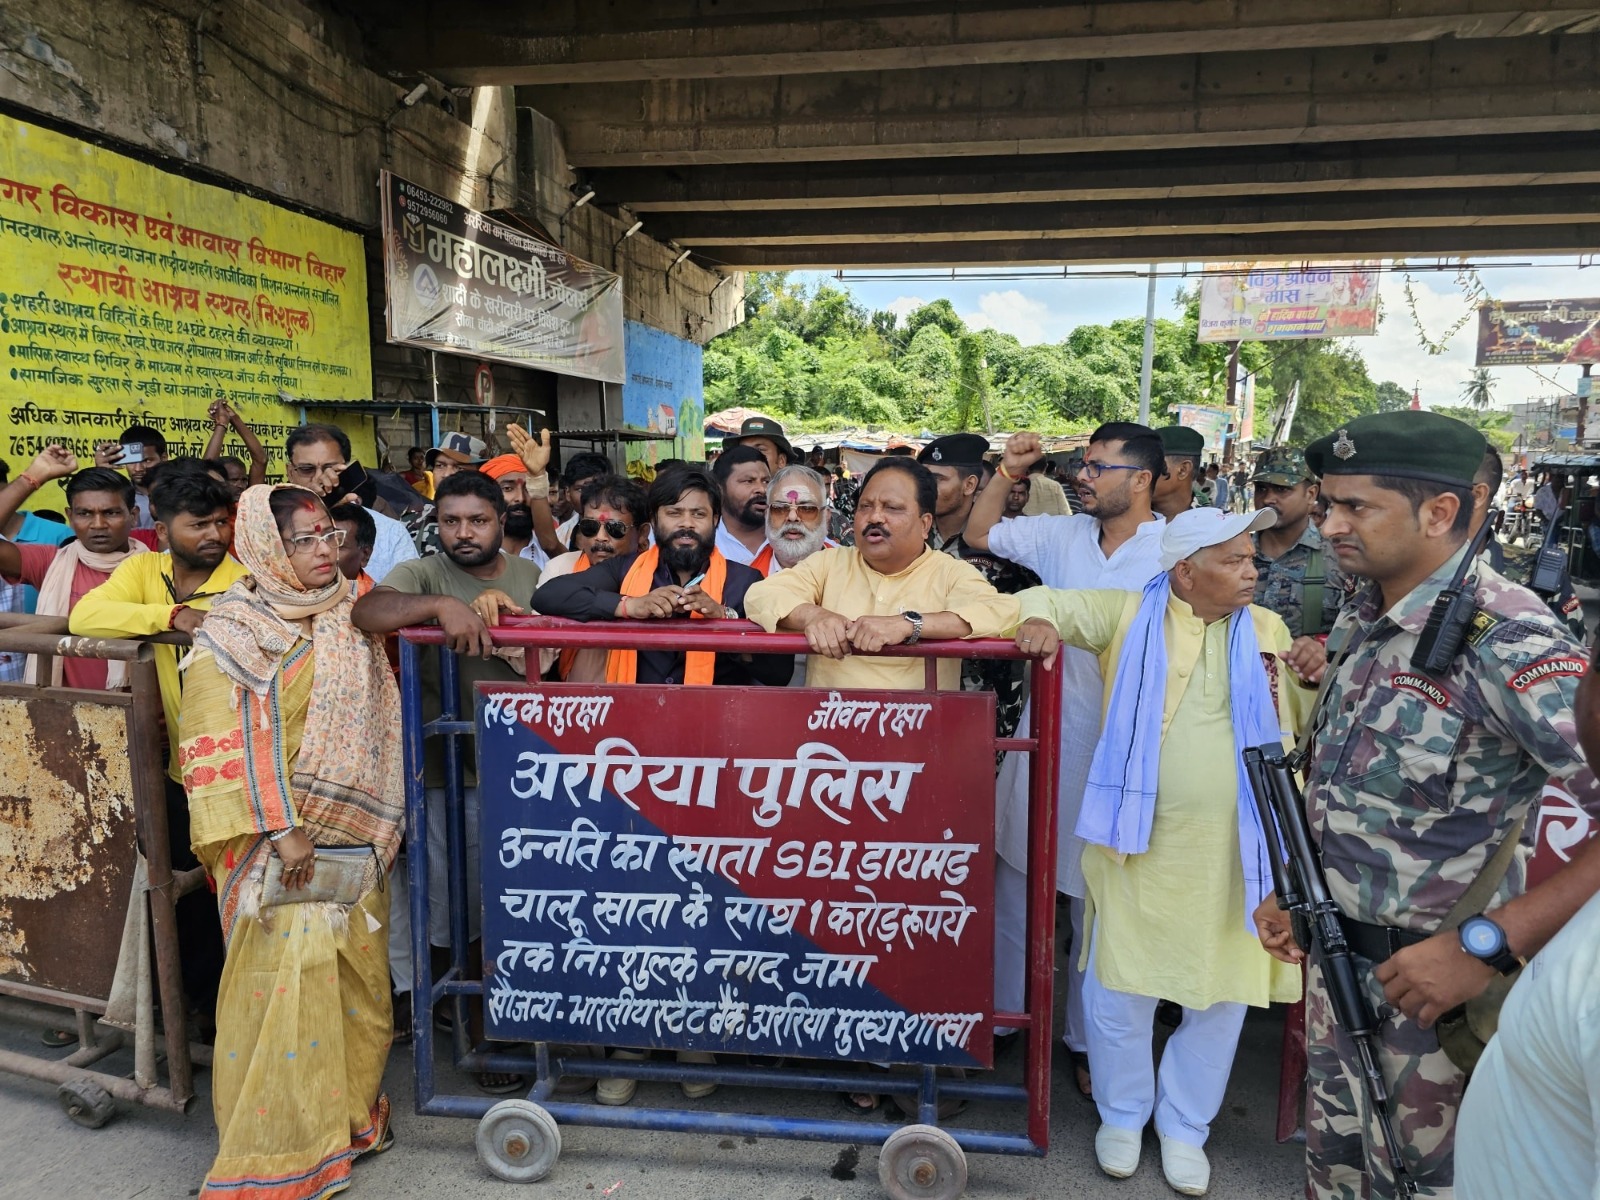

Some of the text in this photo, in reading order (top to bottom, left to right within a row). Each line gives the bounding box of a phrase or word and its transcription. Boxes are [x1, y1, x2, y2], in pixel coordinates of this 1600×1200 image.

[406, 184, 453, 213] 06453-222982
[407, 199, 448, 225] 9572956060
[0, 178, 346, 288] गर विकास एवं आवास विभाग बिहार
[119, 240, 156, 266] योजना
[189, 259, 213, 281] शहरी
[214, 265, 257, 289] आजीविका
[427, 224, 547, 300] महालक्ष्मी
[10, 291, 50, 316] शहरी
[53, 299, 95, 321] आश्रय
[140, 308, 150, 331] के
[152, 311, 173, 336] लिए
[177, 320, 188, 335] 24
[236, 327, 249, 345] की
[57, 263, 136, 300] स्थायी
[140, 277, 200, 314] आश्रय
[205, 291, 251, 327] स्थल
[442, 283, 467, 308] शादी
[470, 288, 481, 309] के
[11, 318, 46, 340] आश्रय
[49, 323, 77, 346] स्थल
[79, 322, 89, 343] में
[16, 341, 53, 364] मासिक
[94, 349, 130, 371] शिविर
[135, 352, 145, 372] के
[148, 360, 182, 376] माध्यम
[257, 370, 270, 385] की
[19, 366, 83, 388] सामाजिक
[87, 374, 120, 393] सुरक्षा
[121, 372, 132, 396] से
[215, 381, 226, 400] के
[8, 402, 57, 425] अधिक
[62, 407, 127, 431] जानकारी
[141, 411, 166, 432] लिए
[169, 415, 201, 436] आश्रय
[271, 421, 284, 439] एवं
[1393, 676, 1446, 705] COMMANDO
[1513, 661, 1584, 690] COMMANDO
[485, 692, 614, 737] सड़क सुरक्षा
[807, 691, 932, 737] जीवन रक्षा
[511, 737, 925, 828] अररिया पुलिस
[499, 817, 980, 886] उन्नति का खाता SBI डायमंड
[500, 888, 589, 938] चालू
[592, 892, 681, 935] खाता
[681, 882, 712, 929] के
[724, 896, 806, 941] साथ
[827, 885, 907, 953] करोड़
[497, 939, 554, 977] तक
[703, 949, 789, 992] नगद
[793, 953, 878, 989] जमा
[568, 986, 659, 1033] भारतीय
[709, 983, 749, 1035] बैंक
[747, 991, 836, 1048] अररिया
[834, 1008, 905, 1057] मुख्य
[898, 1012, 983, 1052] शाखा
